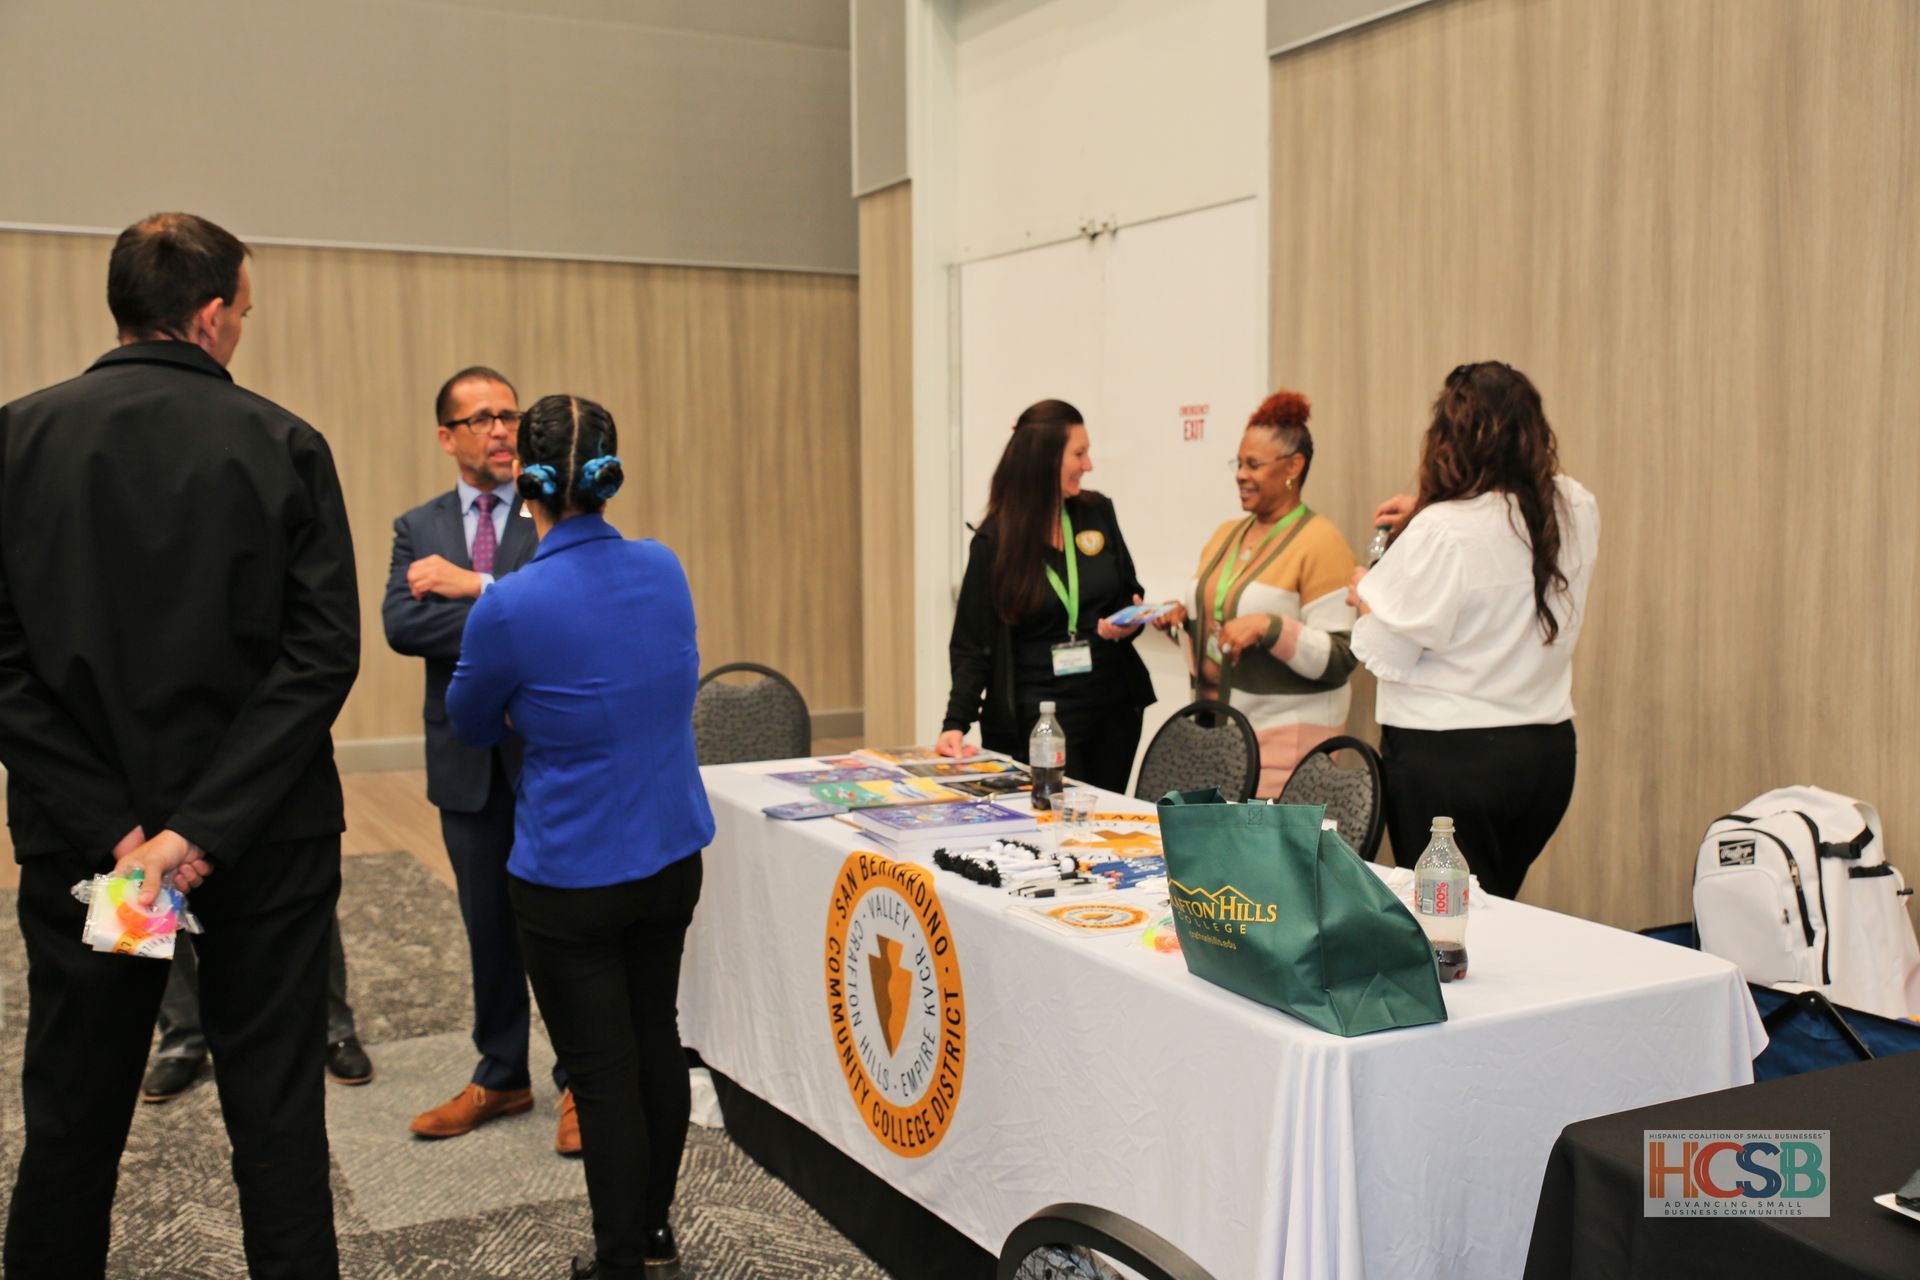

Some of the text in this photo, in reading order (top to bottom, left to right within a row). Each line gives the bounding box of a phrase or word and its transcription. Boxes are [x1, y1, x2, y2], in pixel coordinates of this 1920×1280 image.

[1184, 419, 1205, 441] EXIT
[835, 867, 858, 920] SAN
[1219, 896, 1277, 922] HILLS
[1436, 882, 1447, 913] 100%
[867, 894, 910, 931] VALLEY
[1178, 911, 1247, 935] COLLEGE
[847, 920, 889, 1091] CRAFTON HILLS
[901, 947, 936, 1097] EMPIRE KVCR
[829, 937, 961, 1148] COMMUNITY COLLEGE DISTRICT
